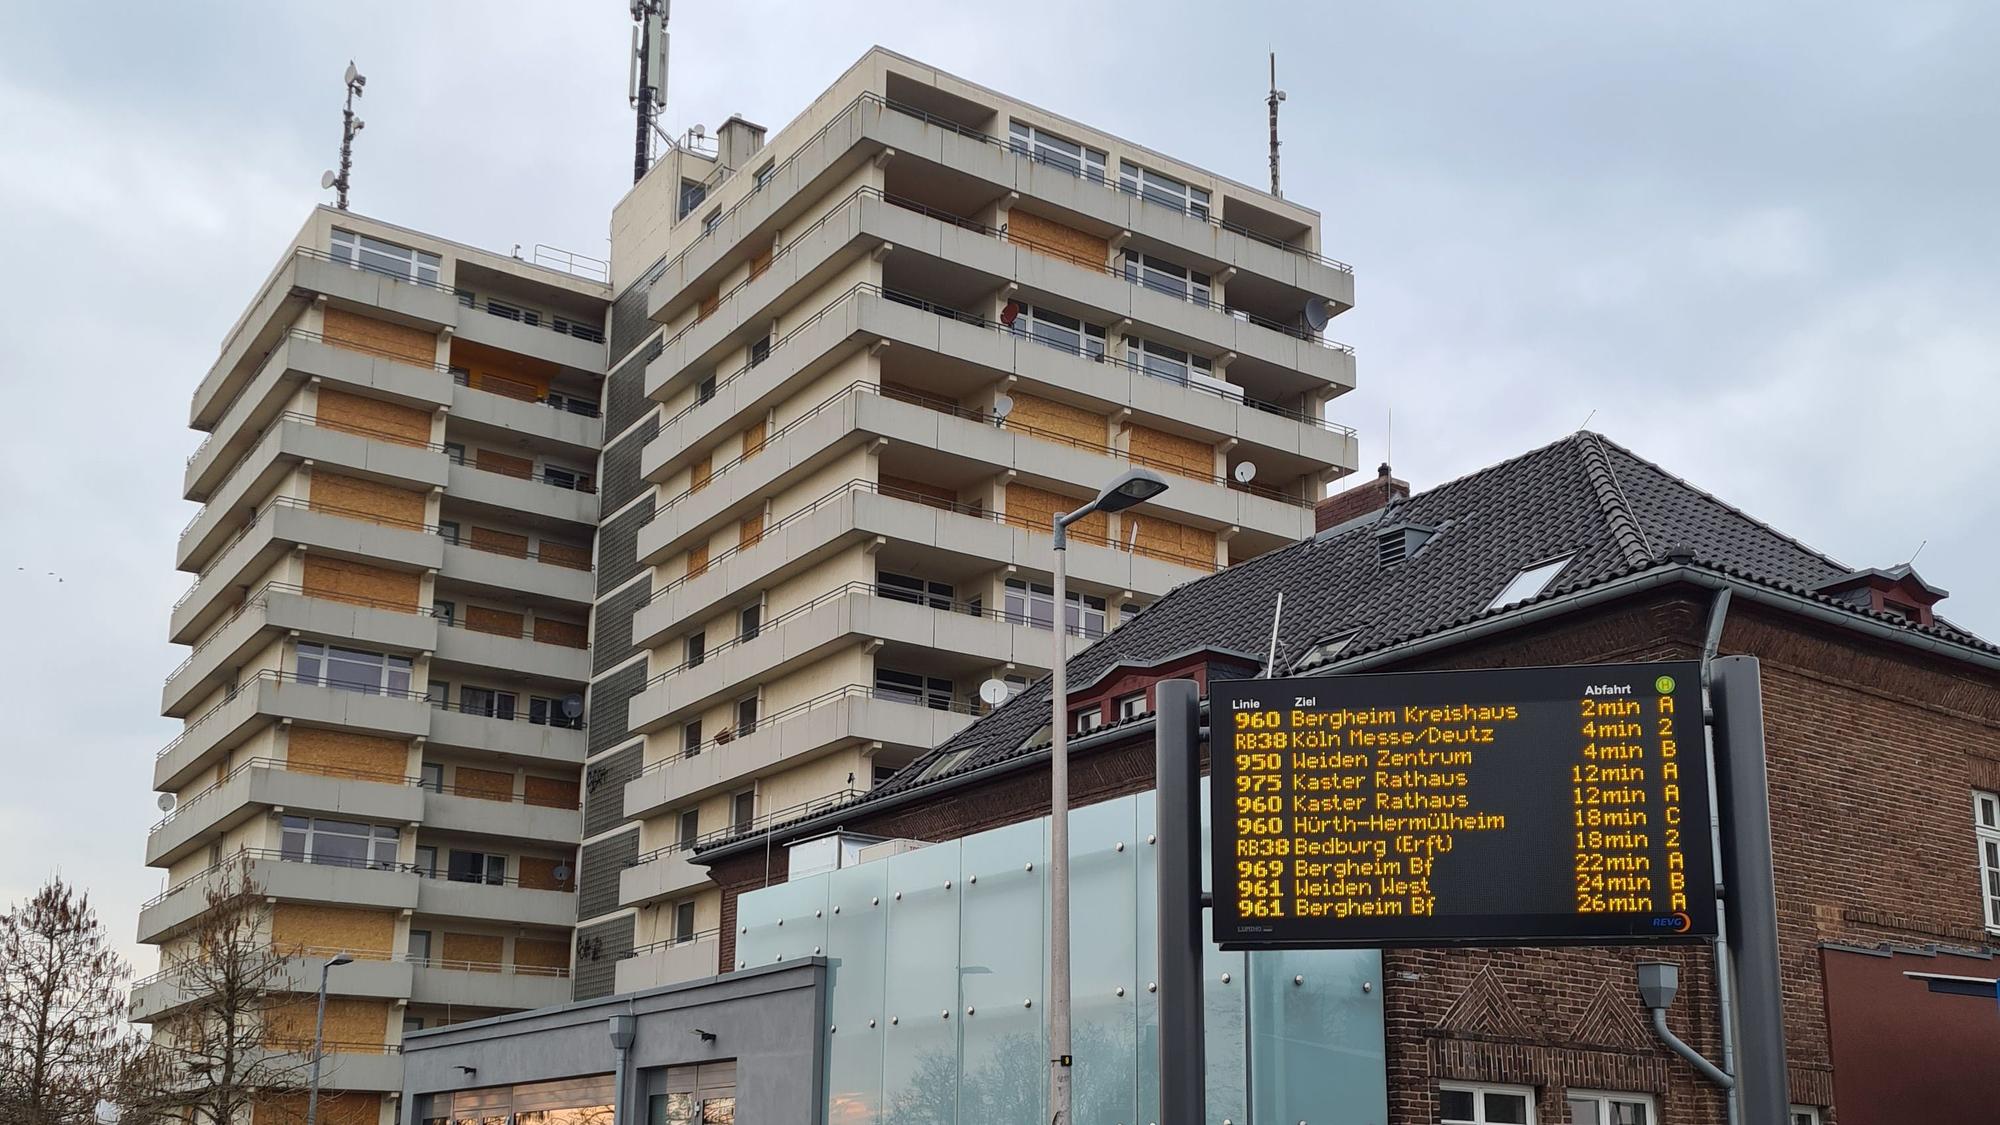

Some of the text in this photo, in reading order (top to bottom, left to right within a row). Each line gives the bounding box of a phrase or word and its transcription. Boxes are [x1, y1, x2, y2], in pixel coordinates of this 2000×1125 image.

[1295, 697, 1316, 707] Ziel
[1585, 685, 1631, 695] Abfahrt
[1232, 699, 1260, 709] Linie
[1236, 711, 1281, 729] 960
[1292, 708, 1396, 730] Bergheim
[1405, 704, 1519, 723] Kreishaus
[1659, 696, 1674, 713] A
[1236, 732, 1288, 750] RB38
[1293, 731, 1341, 748] Köln
[1350, 727, 1494, 746] Messe/Deutz
[1659, 718, 1673, 736] 2
[1236, 753, 1282, 771] 950
[1293, 751, 1368, 769] Weiden
[1377, 749, 1472, 767] Zentrum
[1662, 740, 1677, 757] B
[1237, 775, 1282, 792] 975
[1294, 773, 1366, 790] Kaster
[1376, 771, 1468, 788] Rathaus
[1664, 762, 1678, 779] A
[1237, 796, 1283, 813] 960
[1294, 794, 1367, 811] Kaster
[1376, 792, 1469, 809] Rathaus
[1664, 784, 1680, 801] A
[1238, 817, 1283, 834] 960
[1295, 812, 1505, 833] Hürth-Hermülheim
[1666, 807, 1681, 824] C
[1238, 839, 1290, 856] RB38
[1295, 838, 1387, 857] Bedburg
[1396, 835, 1453, 855] (Erft)
[1666, 830, 1680, 847] 2
[1238, 860, 1284, 878] 969
[1296, 858, 1401, 880] Bergheim
[1410, 857, 1435, 876] Bf
[1669, 852, 1684, 869] A
[1239, 880, 1284, 897] 961
[1296, 879, 1372, 896] Weiden
[1382, 877, 1431, 895] West
[1670, 872, 1685, 890] B
[1239, 899, 1285, 917] 961
[1296, 898, 1402, 917] Bergheim
[1411, 897, 1436, 916] Bf
[1672, 893, 1687, 910] A
[1653, 918, 1681, 926] REVG
